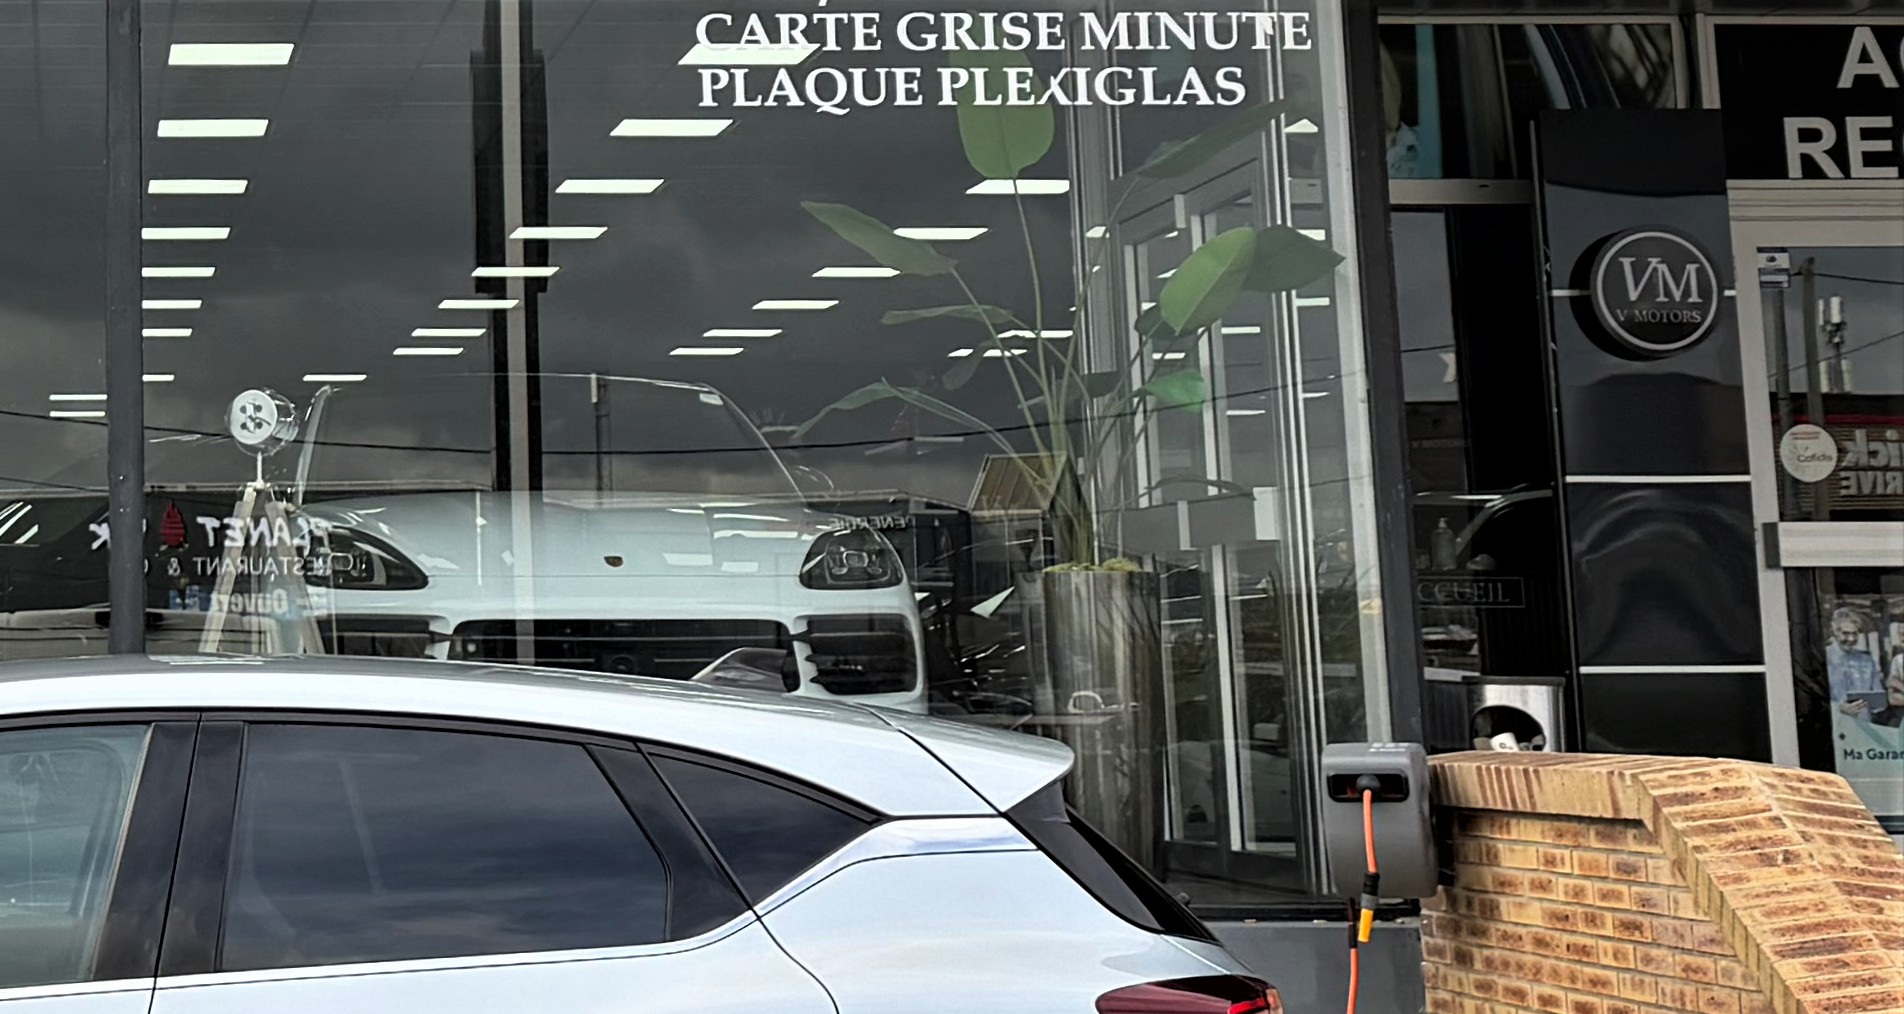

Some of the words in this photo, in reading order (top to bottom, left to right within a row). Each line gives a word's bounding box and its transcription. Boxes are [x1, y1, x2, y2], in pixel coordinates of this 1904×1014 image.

[695, 11, 882, 52] CARTE
[896, 11, 1066, 52] GRISE
[1078, 11, 1313, 52] MINUTE
[1836, 26, 1904, 89] A
[697, 66, 924, 116] PLAQUE
[936, 66, 1248, 107] PLEXIGLAS
[1783, 115, 1904, 179] RE
[1617, 256, 1704, 303] VM
[1615, 308, 1628, 322] V
[1634, 308, 1703, 324] MOTORS
[1843, 748, 1863, 760] Ma
